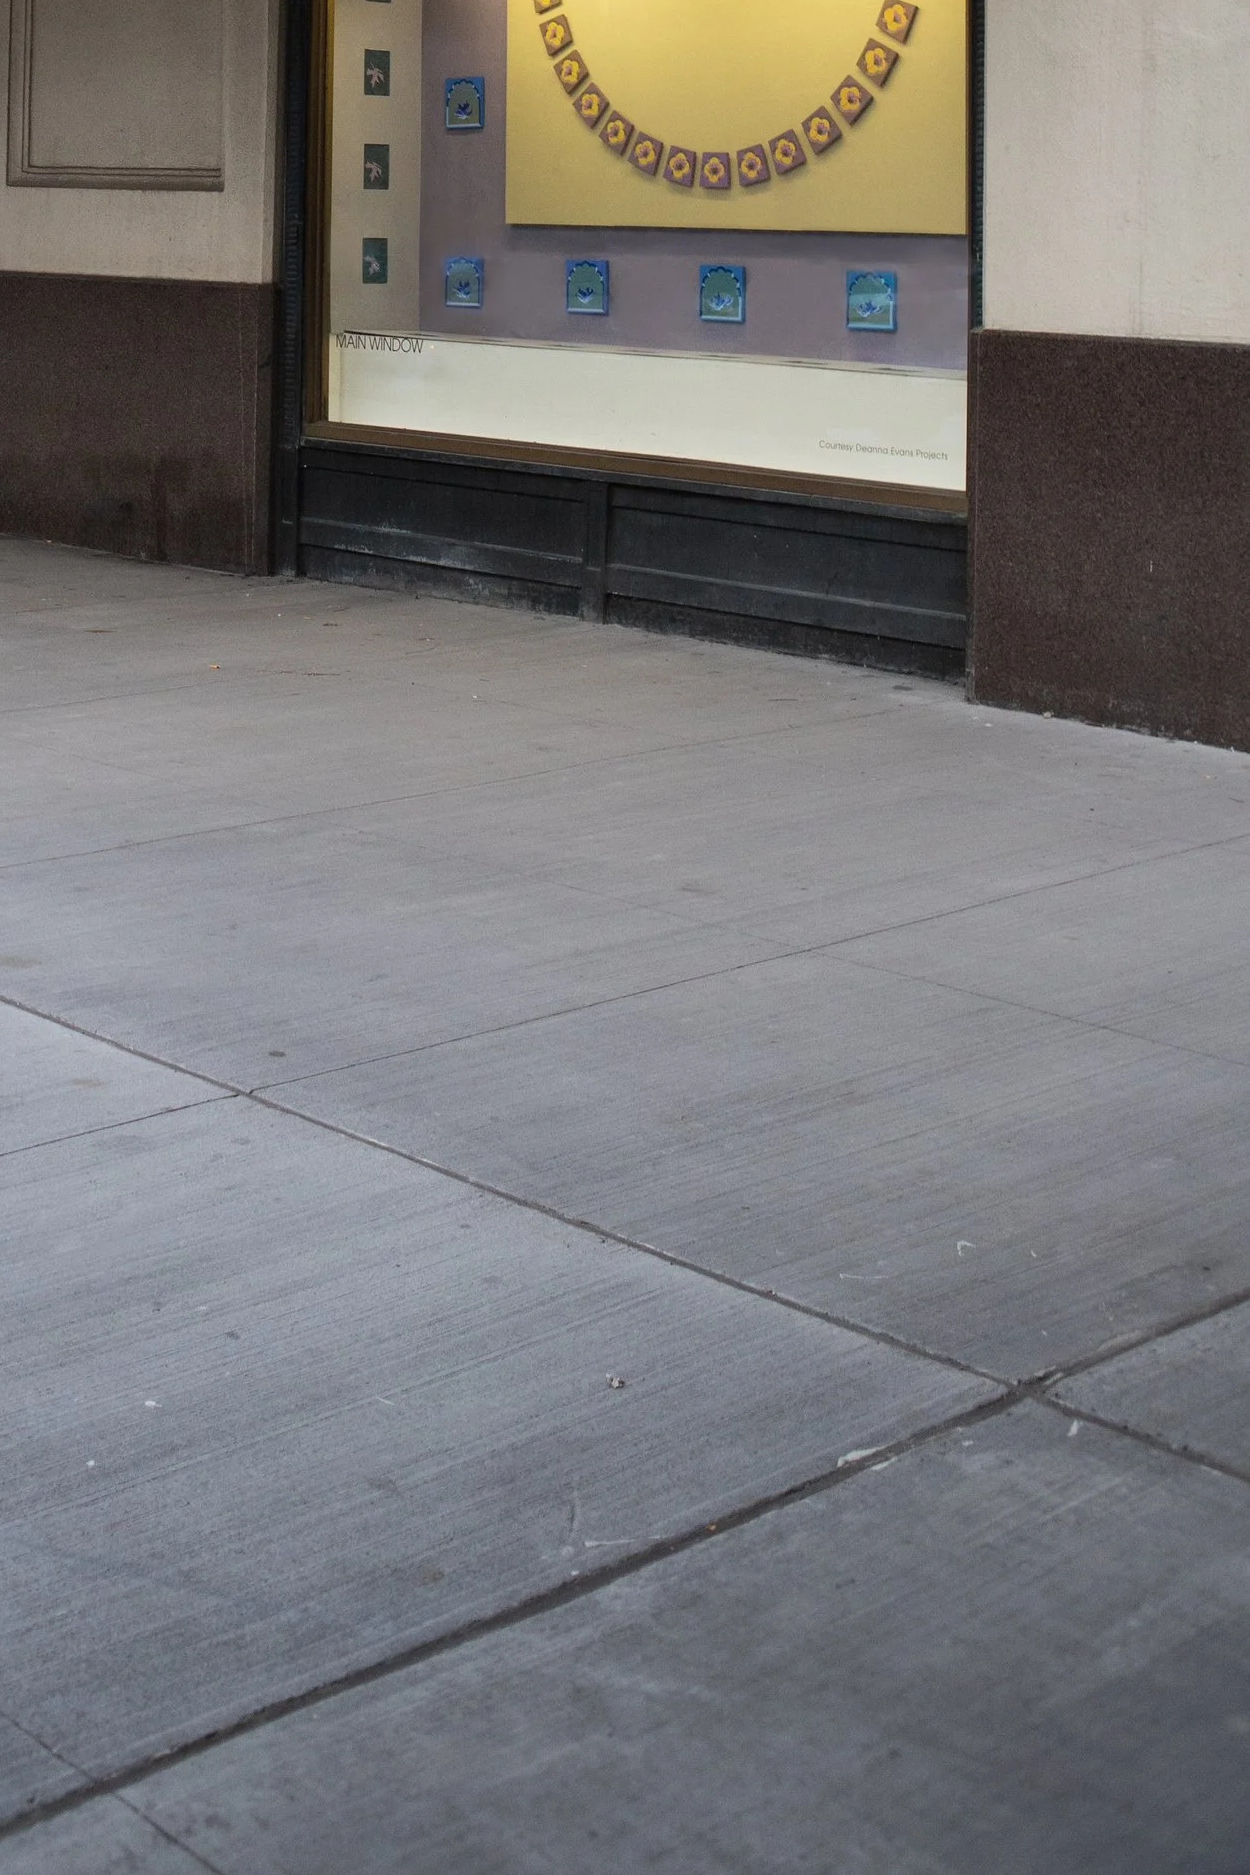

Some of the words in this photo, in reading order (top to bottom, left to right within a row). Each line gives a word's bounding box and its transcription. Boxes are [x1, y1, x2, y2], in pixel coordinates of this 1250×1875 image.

[335, 333, 367, 350] MAIN
[368, 336, 424, 354] WINDOW
[818, 439, 854, 453] Courtesy
[855, 443, 889, 455] Deanna
[890, 446, 914, 458] Evans
[915, 448, 949, 461] Projects
